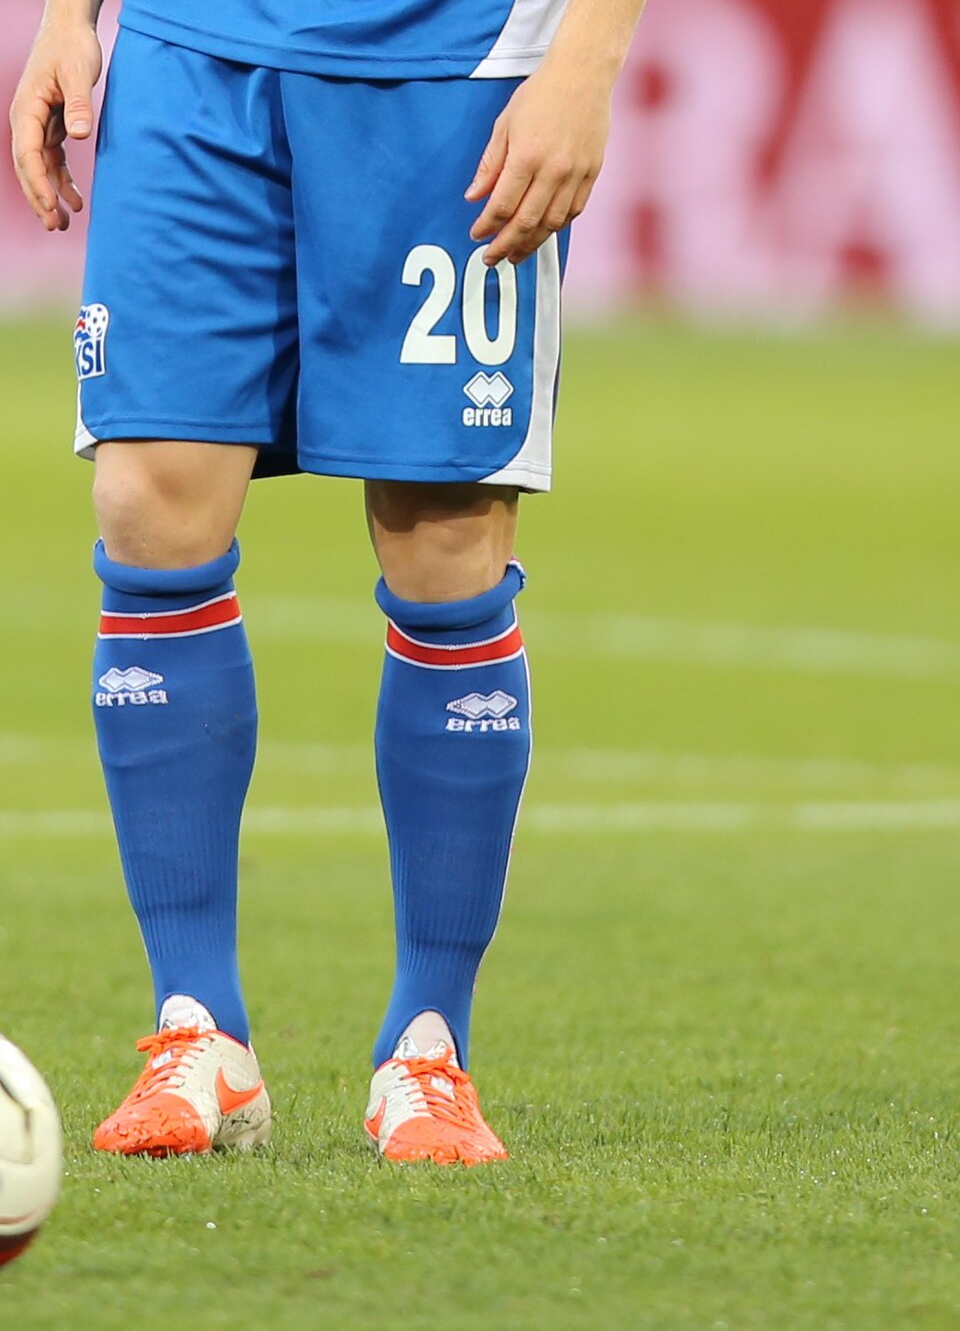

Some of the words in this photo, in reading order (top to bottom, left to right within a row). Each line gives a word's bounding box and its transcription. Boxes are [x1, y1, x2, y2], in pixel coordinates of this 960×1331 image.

[399, 243, 518, 366] 20
[462, 407, 513, 427] errea
[95, 689, 169, 707] errea
[445, 716, 521, 733] errea
